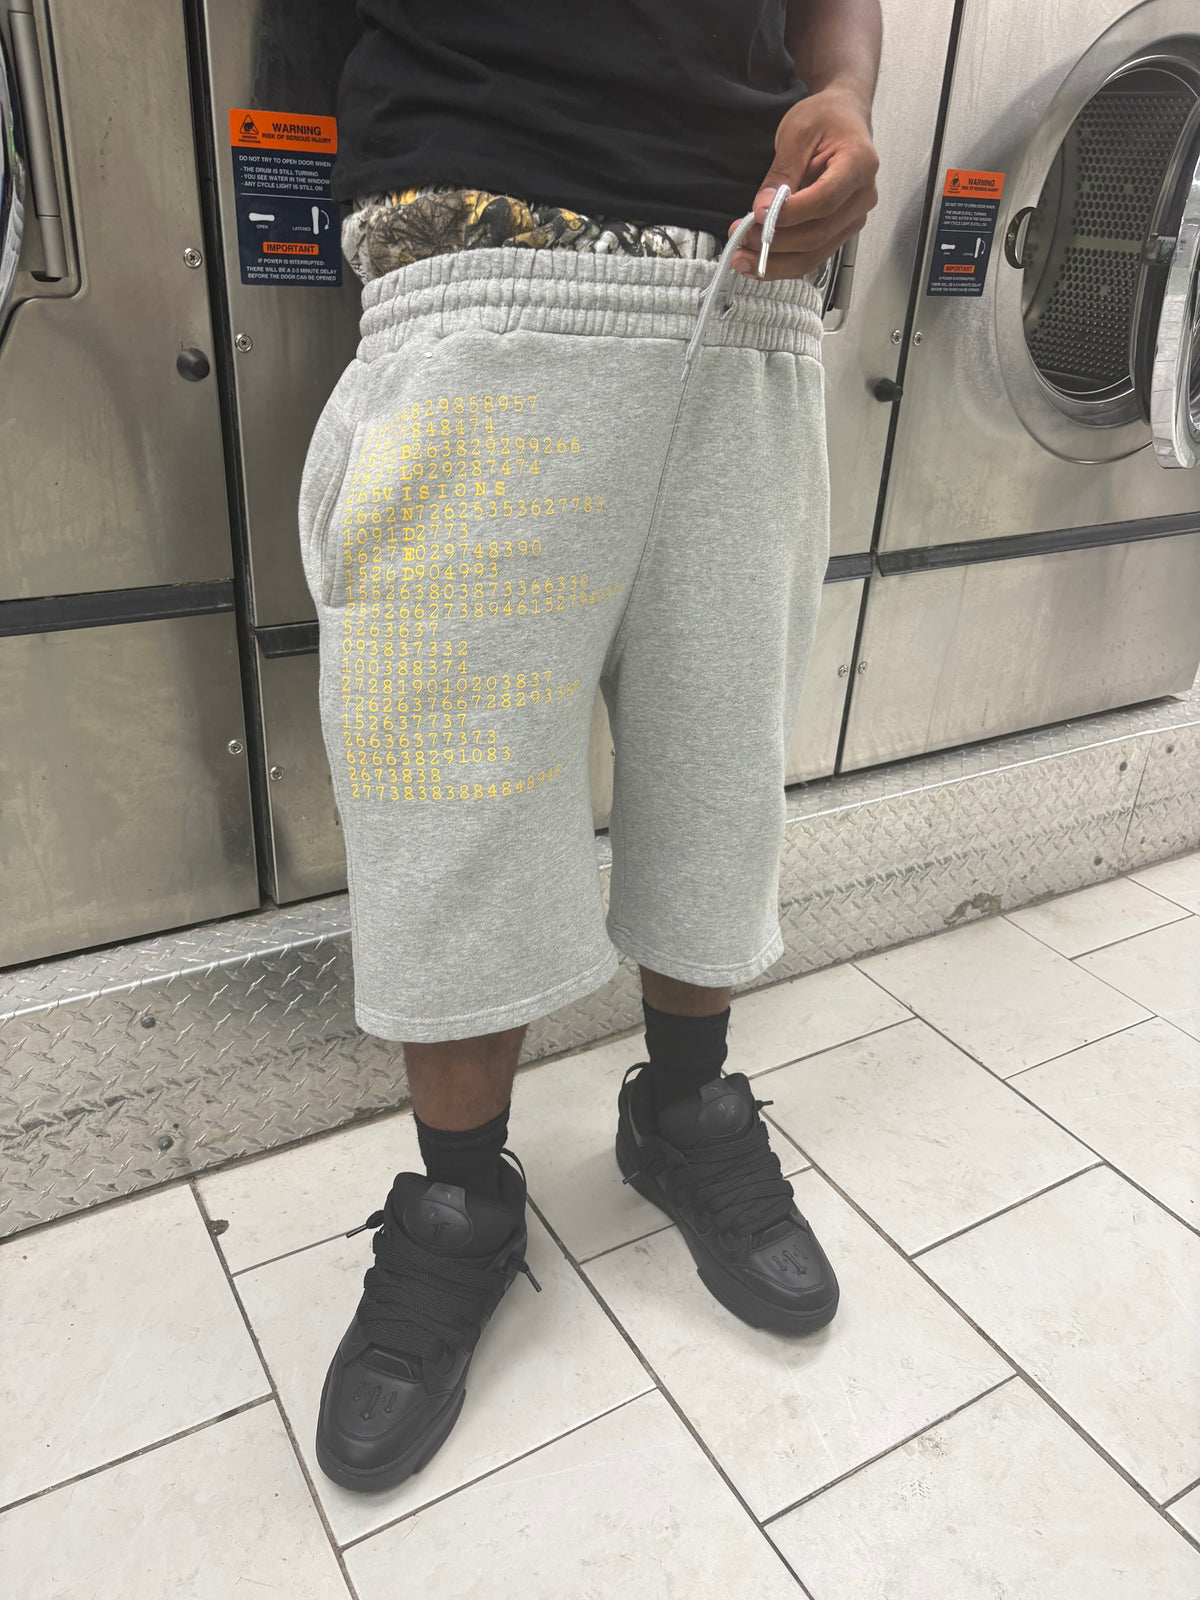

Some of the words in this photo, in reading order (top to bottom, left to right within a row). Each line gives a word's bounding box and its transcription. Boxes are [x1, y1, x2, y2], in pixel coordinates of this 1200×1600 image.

[272, 122, 322, 136] WARNING
[286, 134, 311, 142] SERIOUS
[968, 178, 996, 187] WARNING
[266, 244, 315, 253] IMPORTANT
[342, 522, 469, 547] 1091D2773
[343, 540, 542, 567] 3627E029748390
[345, 562, 498, 584] 1526D904993
[343, 619, 438, 638] 5263637
[342, 638, 468, 657] 093837332
[341, 657, 467, 677] 100388374
[341, 670, 553, 695] 272819010203837
[341, 712, 467, 731] 152637737
[343, 729, 496, 749] 26636377373
[346, 745, 511, 766] 626638291083
[348, 765, 441, 783] 2673838
